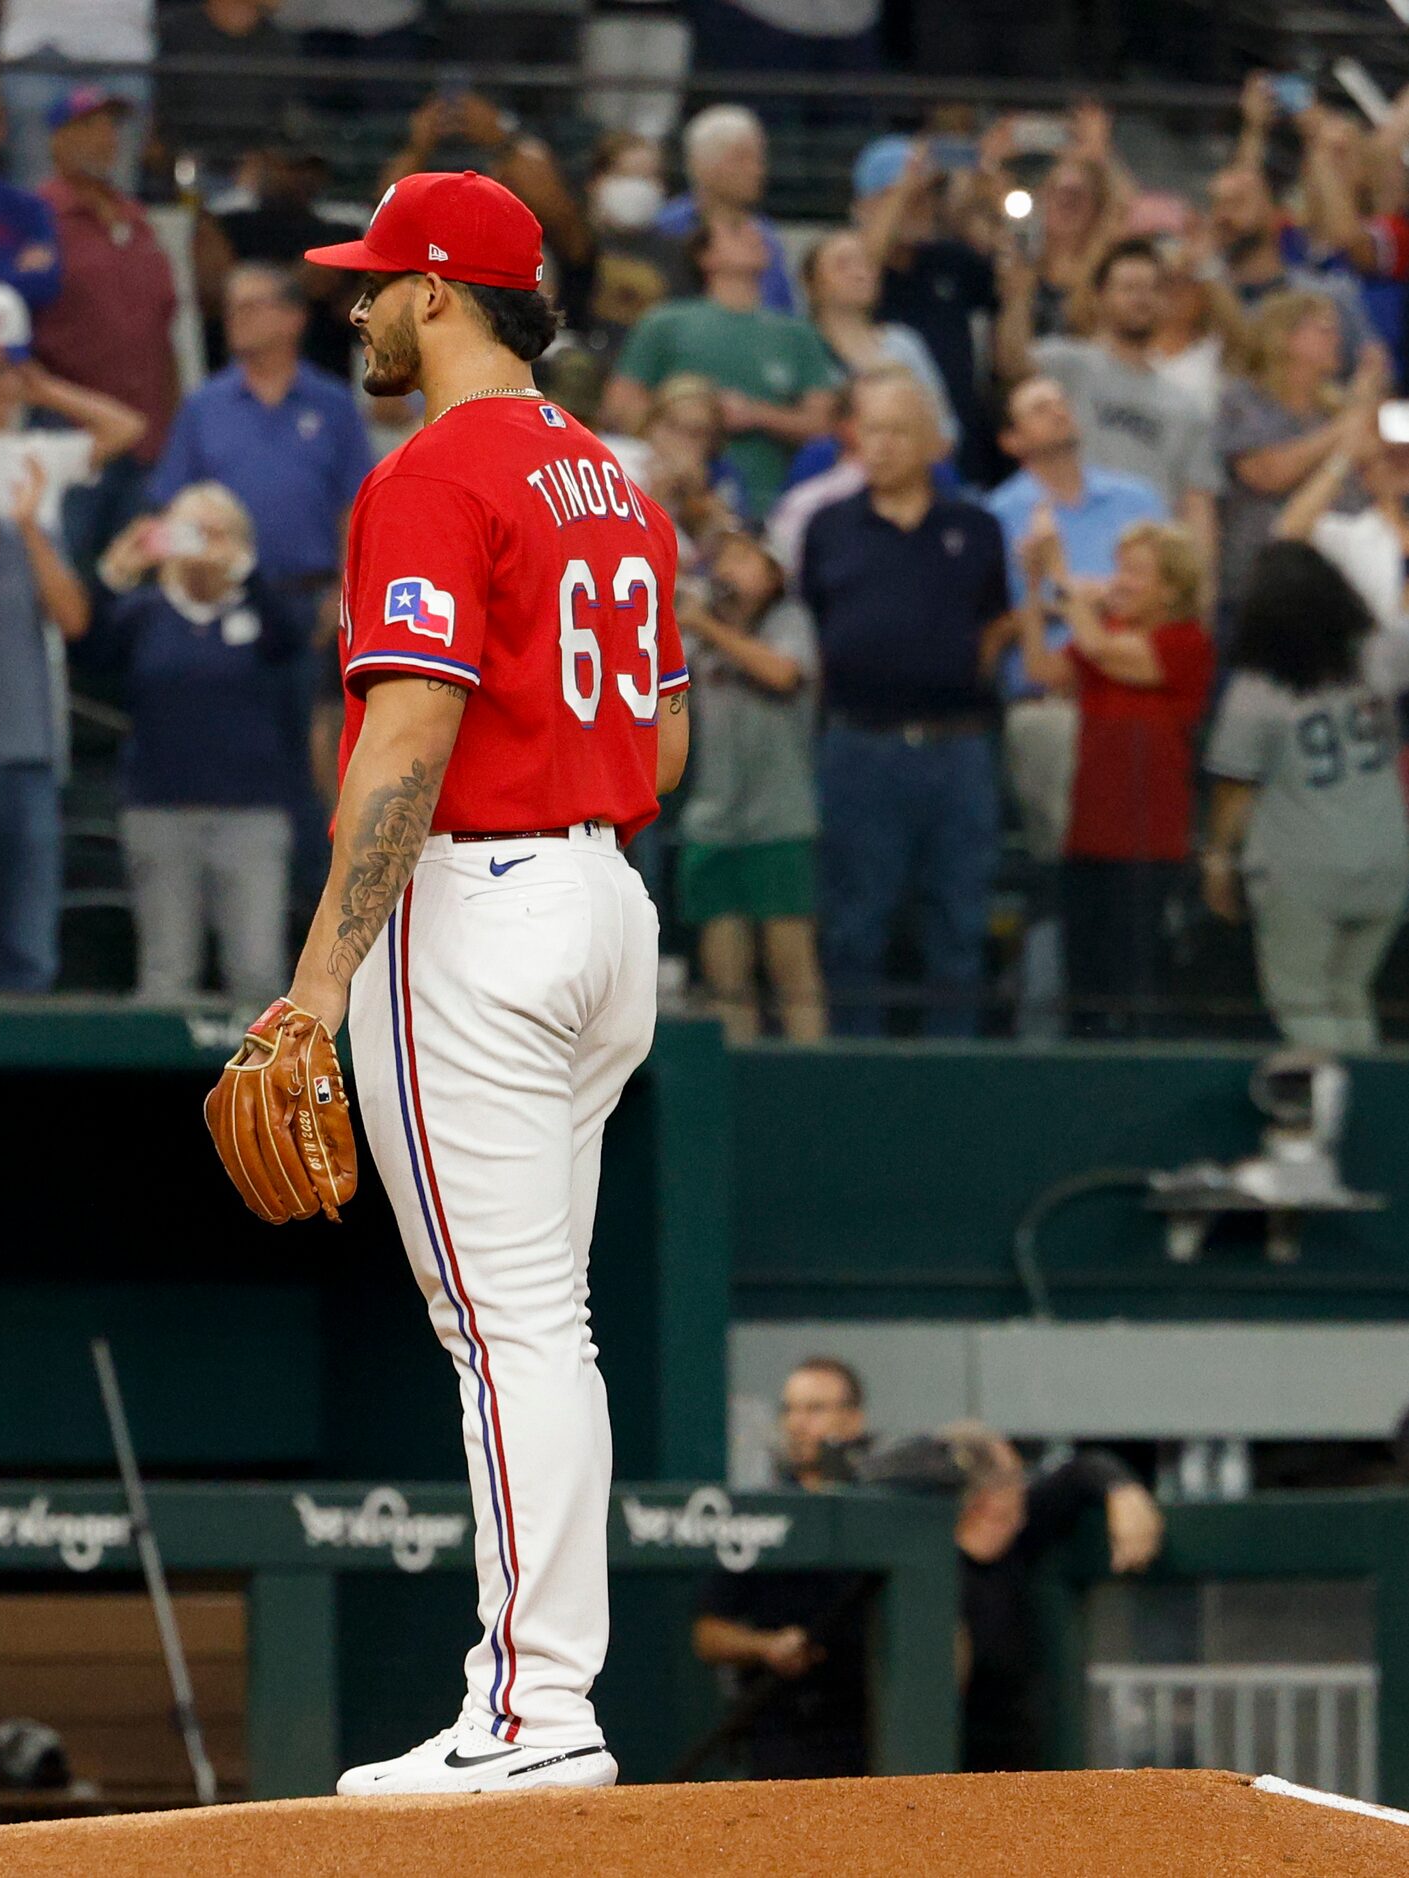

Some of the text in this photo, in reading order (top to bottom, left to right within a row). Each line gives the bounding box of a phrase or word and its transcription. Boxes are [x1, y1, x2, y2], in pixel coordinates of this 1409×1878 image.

[558, 556, 659, 729] 63
[1295, 702, 1393, 790] 99
[348, 1486, 468, 1573] Kroger
[672, 1486, 792, 1573] Kroger
